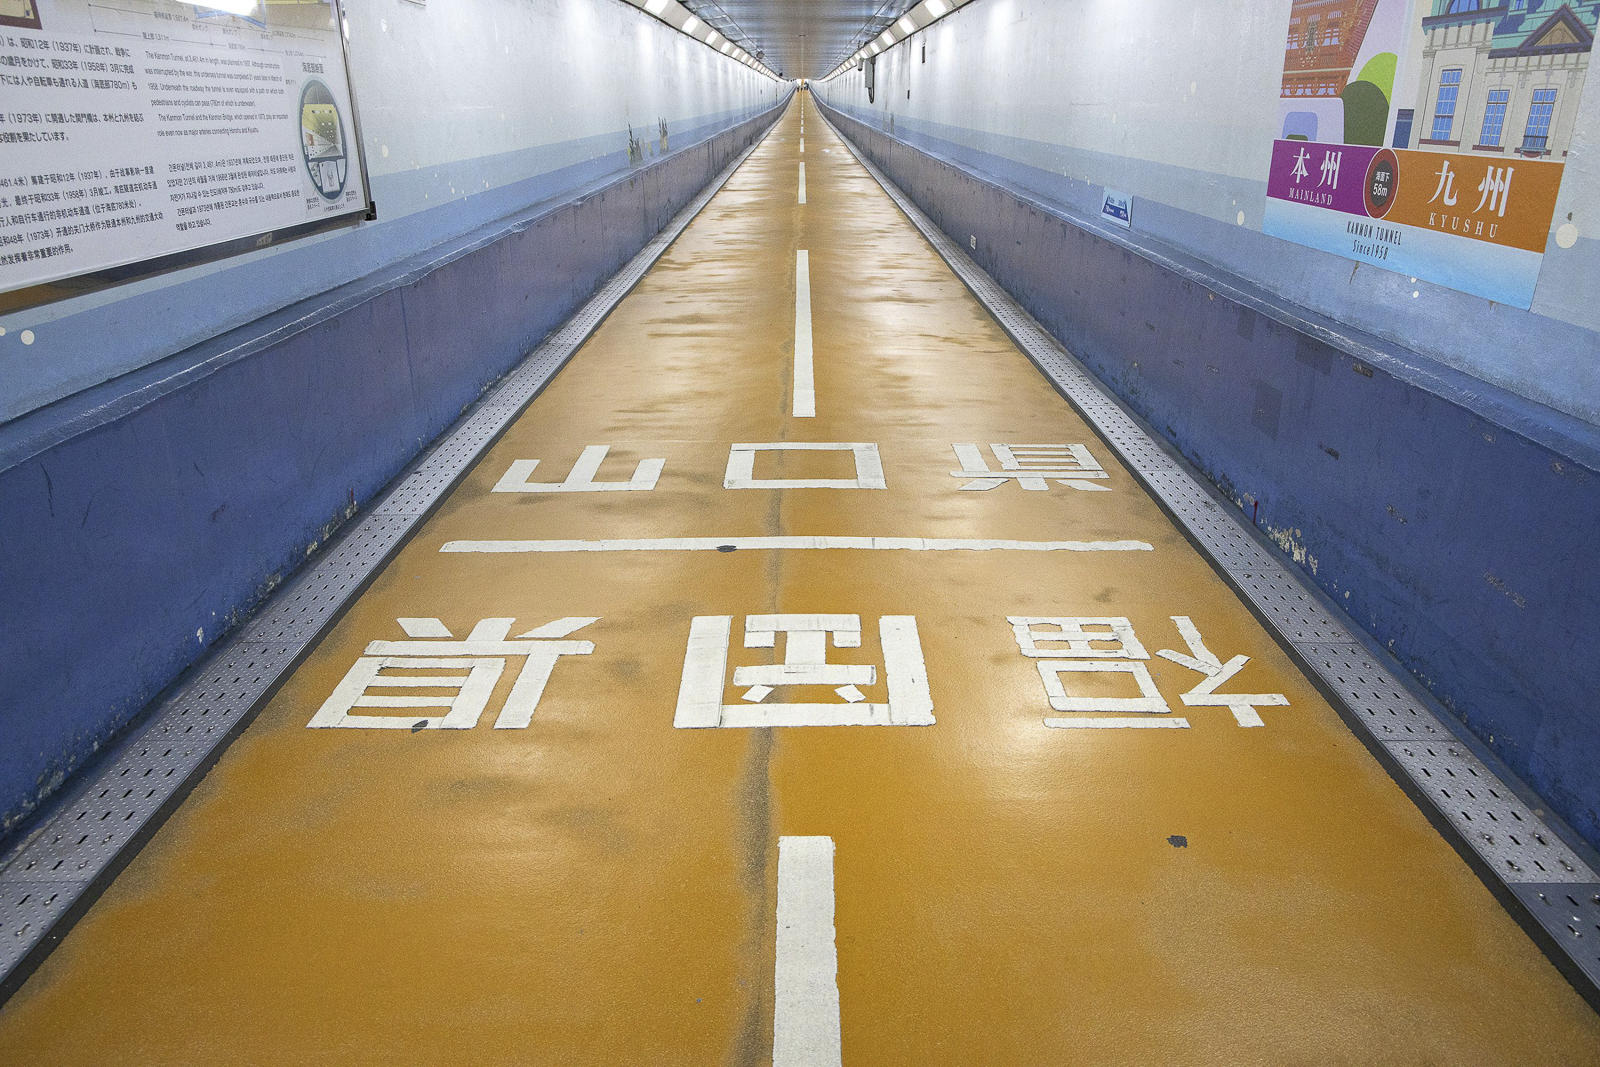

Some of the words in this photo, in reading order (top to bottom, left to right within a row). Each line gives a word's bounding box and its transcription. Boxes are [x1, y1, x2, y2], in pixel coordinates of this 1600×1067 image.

[145, 50, 153, 59] The
[154, 52, 170, 60] Kanmon
[154, 68, 174, 77] interrupted
[174, 69, 179, 78] by
[160, 83, 182, 91] Underneath
[190, 85, 204, 93] roadway
[151, 99, 173, 107] pedestrians
[182, 99, 194, 108] cyclists
[158, 113, 166, 122] The
[182, 113, 195, 121] Tunnel
[157, 129, 165, 137] role
[189, 129, 198, 137] major
[1289, 147, 1342, 189] 本州
[1288, 187, 1333, 206] MAINLAND
[1373, 183, 1388, 198] 58m
[1427, 160, 1515, 217] 九州
[1347, 221, 1373, 240] KANMON
[1376, 226, 1403, 246] TUNNEL
[1428, 213, 1499, 238] KYUSHU
[490, 442, 1111, 493] 山口県
[306, 613, 1291, 730] 福岡県
